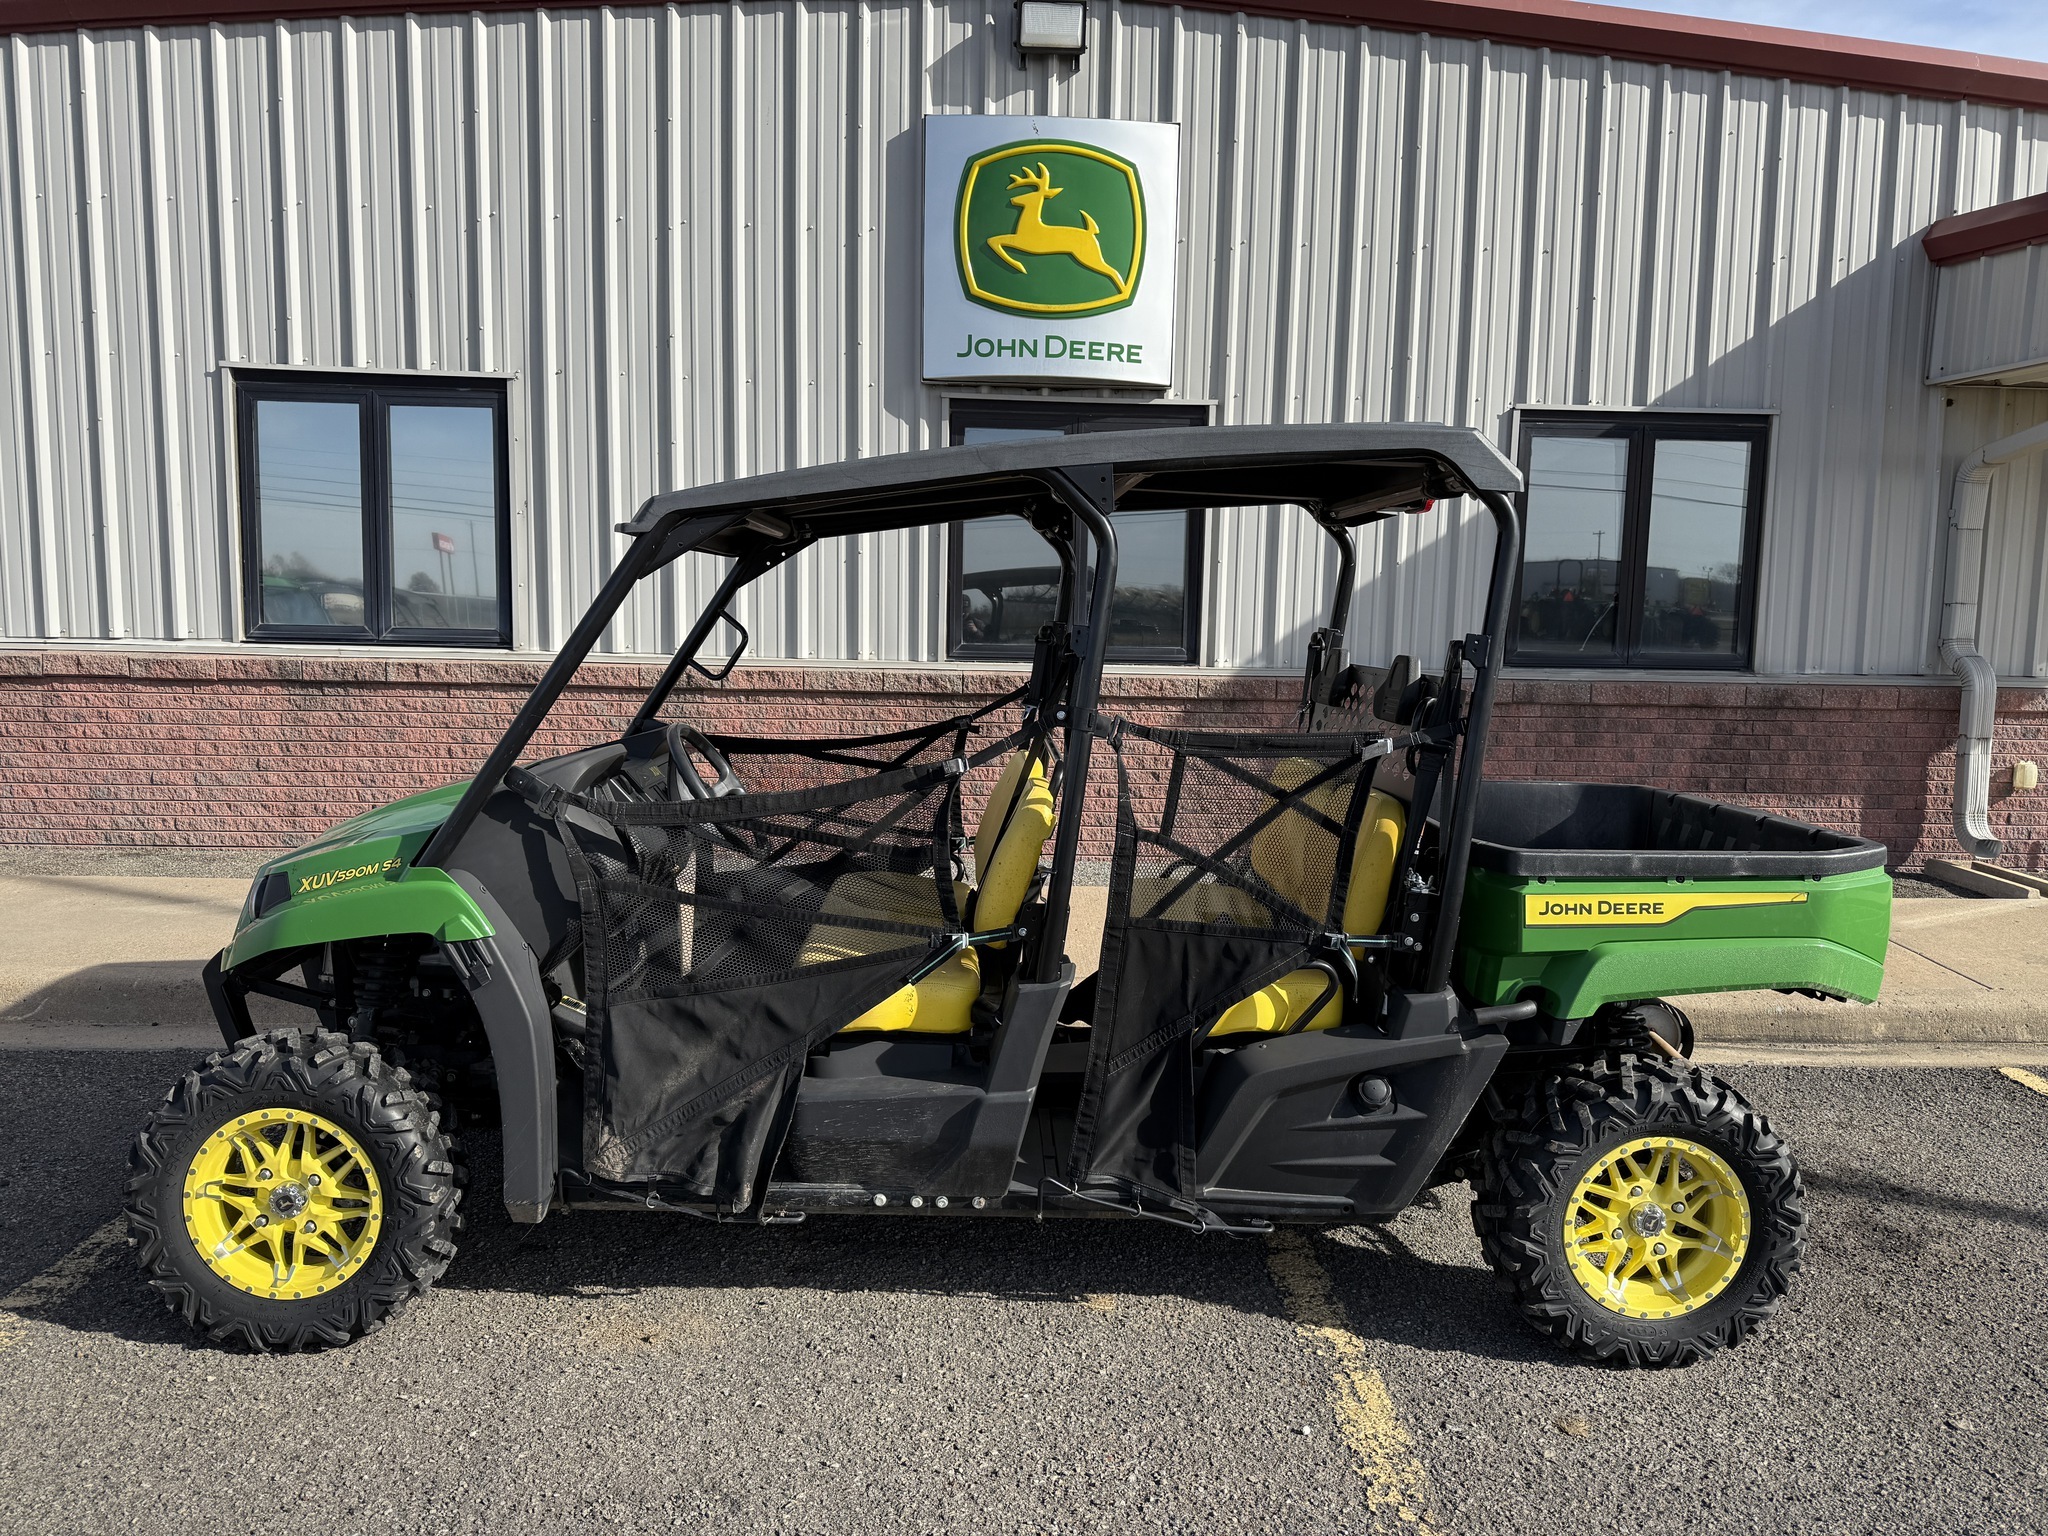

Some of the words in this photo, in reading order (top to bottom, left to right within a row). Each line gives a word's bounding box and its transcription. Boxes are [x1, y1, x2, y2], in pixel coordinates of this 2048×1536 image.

[957, 334, 1038, 358] JOHN
[1045, 335, 1143, 364] DEERE
[297, 862, 379, 894] XUV590M
[381, 857, 402, 872] S4
[1538, 901, 1592, 916] JOHN
[1597, 901, 1665, 915] DEERE
